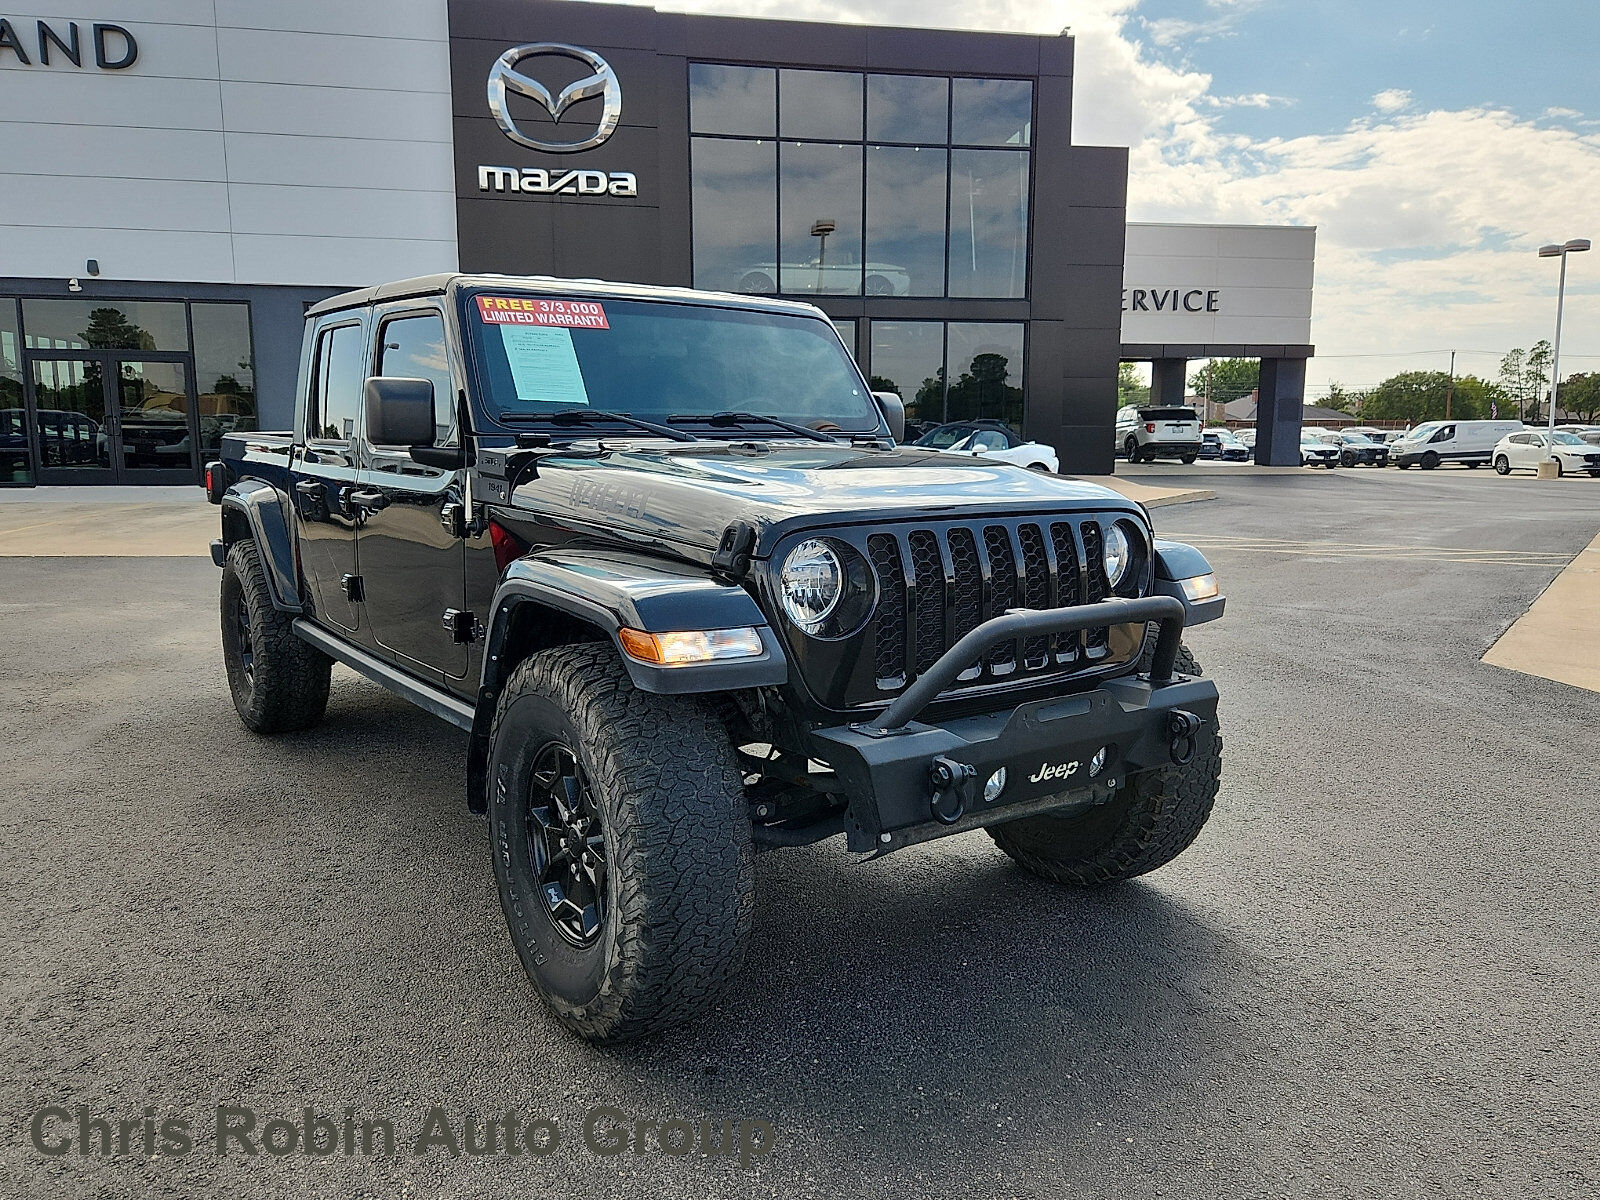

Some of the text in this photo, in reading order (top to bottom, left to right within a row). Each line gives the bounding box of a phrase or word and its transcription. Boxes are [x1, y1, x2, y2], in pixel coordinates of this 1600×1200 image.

[482, 297, 599, 315] FREE 3/3,000
[482, 310, 605, 326] LIMITED WARRANTY
[1028, 760, 1080, 783] Jeep
